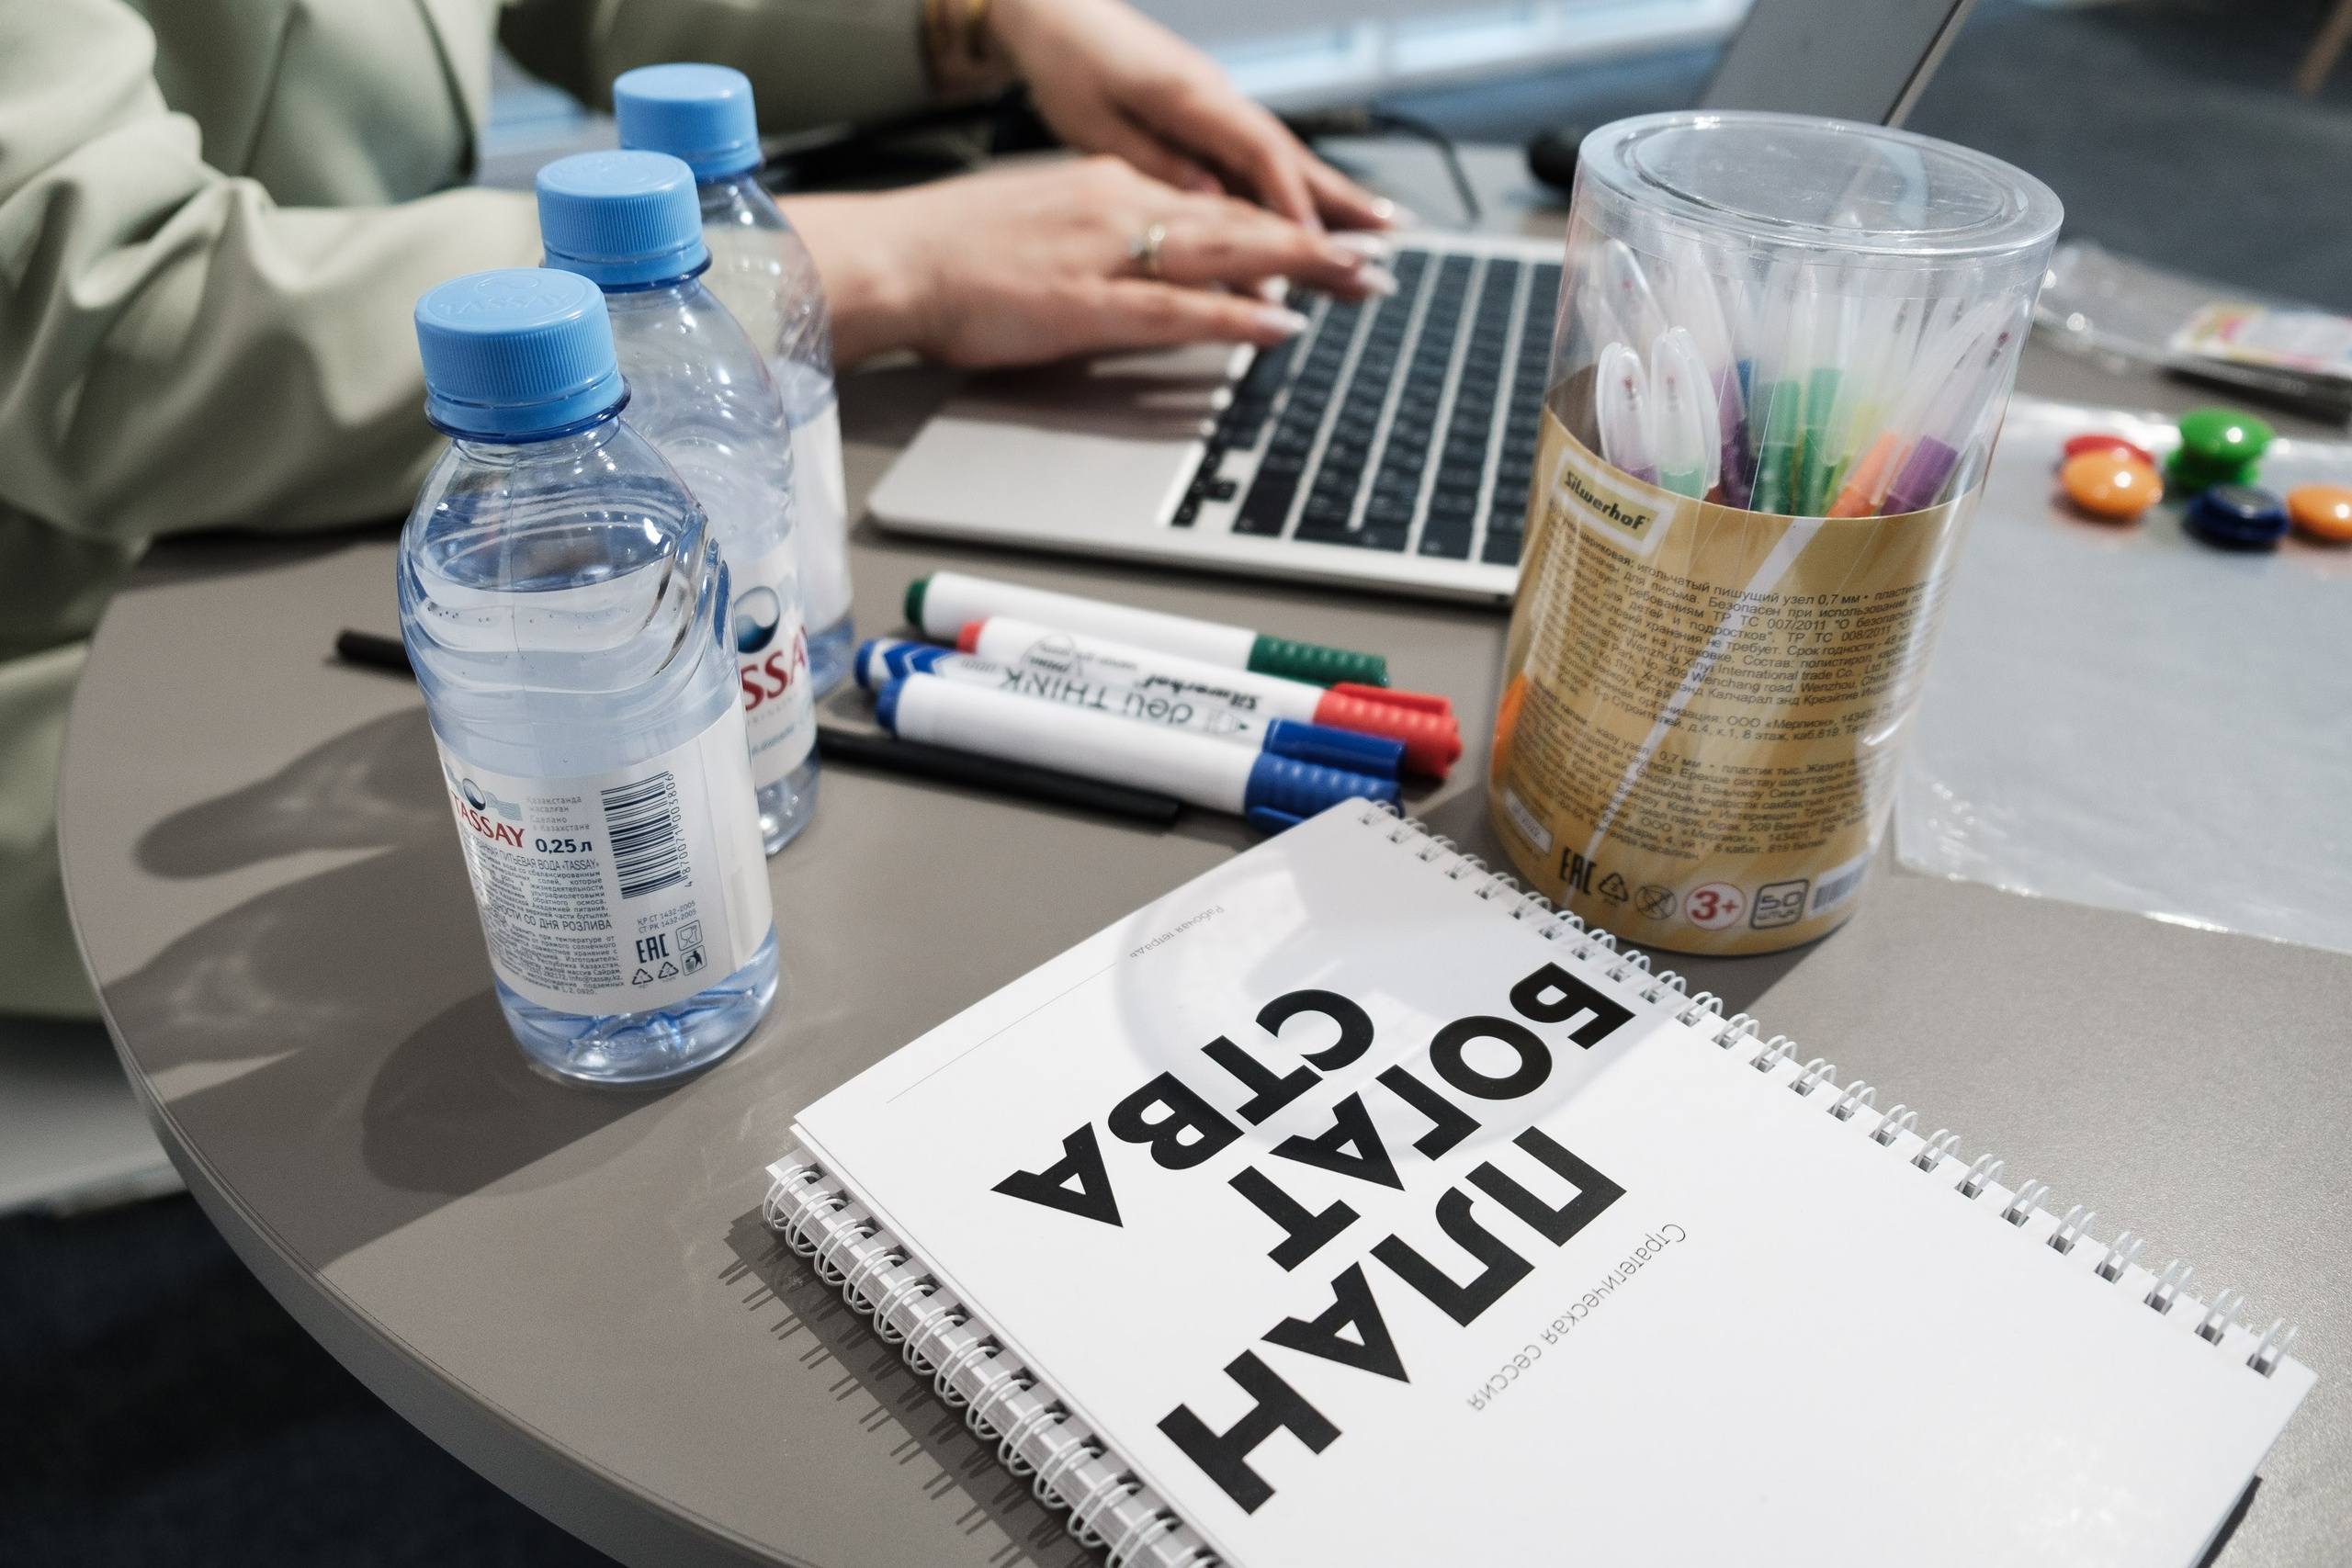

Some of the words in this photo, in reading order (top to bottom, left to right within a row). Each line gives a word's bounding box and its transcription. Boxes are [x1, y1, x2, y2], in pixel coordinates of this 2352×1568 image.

[1565, 470, 1647, 530] Silwerhof
[1624, 571, 1645, 586] для
[1651, 582, 1699, 604] письма.
[1708, 597, 1781, 616] Безопасен
[1788, 610, 1812, 619] при
[1819, 600, 1907, 617] использовании
[1638, 562, 1710, 592] игольчатый
[1714, 586, 1780, 603] пишущий
[1783, 596, 1814, 609] узел
[1817, 594, 1838, 606] 0,7
[1624, 584, 1704, 617] требованиям
[1713, 611, 1732, 622] ТР
[1741, 615, 1759, 627] ТС
[1768, 619, 1826, 630] 007/2011
[1856, 605, 1921, 627] безопасност
[1629, 601, 1664, 620] детей
[1673, 616, 1680, 625] и
[1788, 633, 1805, 643] ТР
[1815, 633, 1833, 643] ТС
[1841, 625, 1891, 642] 008/2011
[1609, 617, 1646, 641] смотри
[1652, 638, 1667, 648] на
[1673, 644, 1735, 662] упаковке.
[1744, 655, 1794, 668] Состав:
[1707, 637, 1722, 648] не
[1726, 640, 1781, 655] требует.
[1787, 646, 1819, 657] Срок
[1823, 642, 1875, 656] годности
[741, 623, 806, 712] SSA
[1625, 637, 1679, 664] Wenzhou
[1718, 663, 1798, 681] International
[1802, 671, 1833, 681] trade
[998, 667, 1108, 711] THINK
[1665, 665, 1688, 678] 209
[1691, 671, 1761, 693] Wenchang
[1765, 682, 1795, 694] road,
[1612, 695, 1684, 730] Строителей,
[1639, 695, 1722, 724] организация:
[1727, 716, 1761, 728] ООО
[1708, 689, 1773, 705] Калчарал
[1777, 697, 1799, 705] энд
[451, 791, 525, 849] TASSAY
[535, 838, 578, 855] 0,25
[581, 840, 594, 853] л
[528, 869, 601, 879] сбалансированным
[537, 859, 561, 872] ВОДА
[562, 858, 600, 872] «TASSAY»
[1560, 846, 1597, 896] EAC
[530, 884, 604, 893] жизнедеятельности
[530, 890, 605, 900] ультрафиолетовыми
[533, 897, 569, 907] обратного
[1759, 890, 1803, 910] 50
[532, 902, 571, 912] Академией
[554, 911, 574, 919] части
[576, 912, 611, 921] бутылки.
[650, 923, 660, 931] РК
[662, 908, 697, 928] 1432-2005
[661, 900, 695, 919] 1432-2005
[1174, 905, 1225, 933] Рабочая
[1692, 890, 1737, 921] 3+
[524, 914, 537, 927] СО
[540, 919, 560, 931] ДНЯ
[562, 919, 613, 931] РОЗЛИВА
[541, 940, 570, 949] прямого
[636, 933, 670, 964] EAC
[1129, 931, 1176, 958] тетрадь
[989, 988, 1375, 1228] СТВА
[1227, 962, 1636, 1272] БОГАТ
[1541, 1224, 1687, 1345] Стратегическая
[1156, 1126, 1627, 1516] ПЛАН
[1466, 1344, 1543, 1411] сессия
